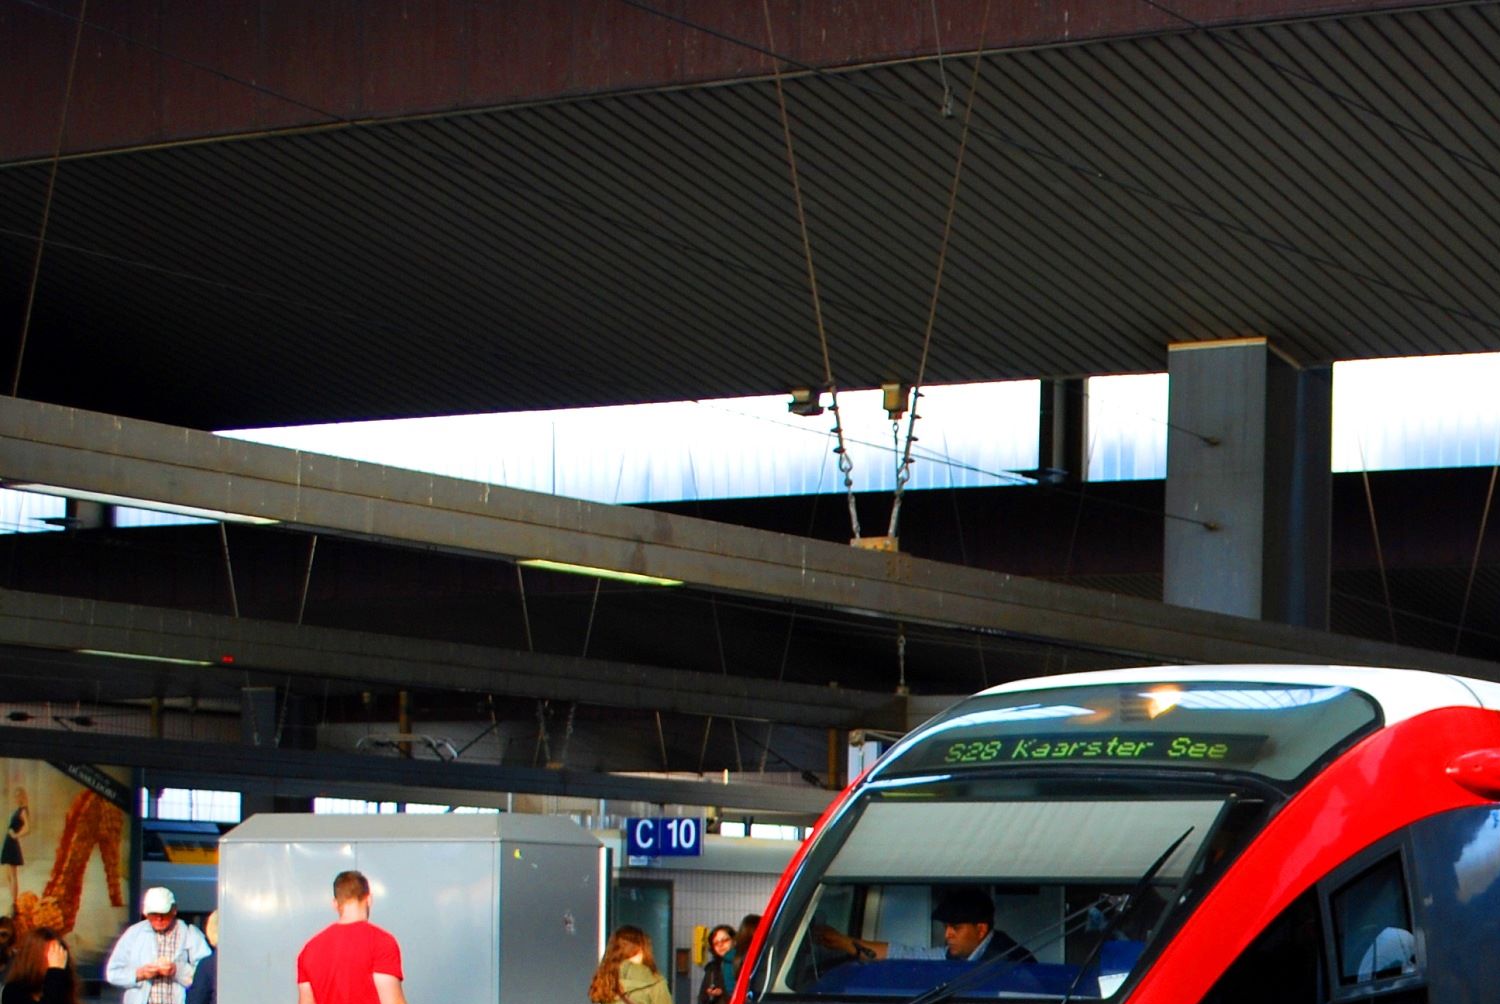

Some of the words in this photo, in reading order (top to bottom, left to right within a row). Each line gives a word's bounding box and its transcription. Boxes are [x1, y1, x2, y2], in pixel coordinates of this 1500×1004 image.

[944, 741, 1002, 762] S28
[1012, 737, 1154, 760] Kaarster
[1167, 737, 1229, 760] See
[636, 819, 653, 849] C
[666, 819, 696, 849] 10
